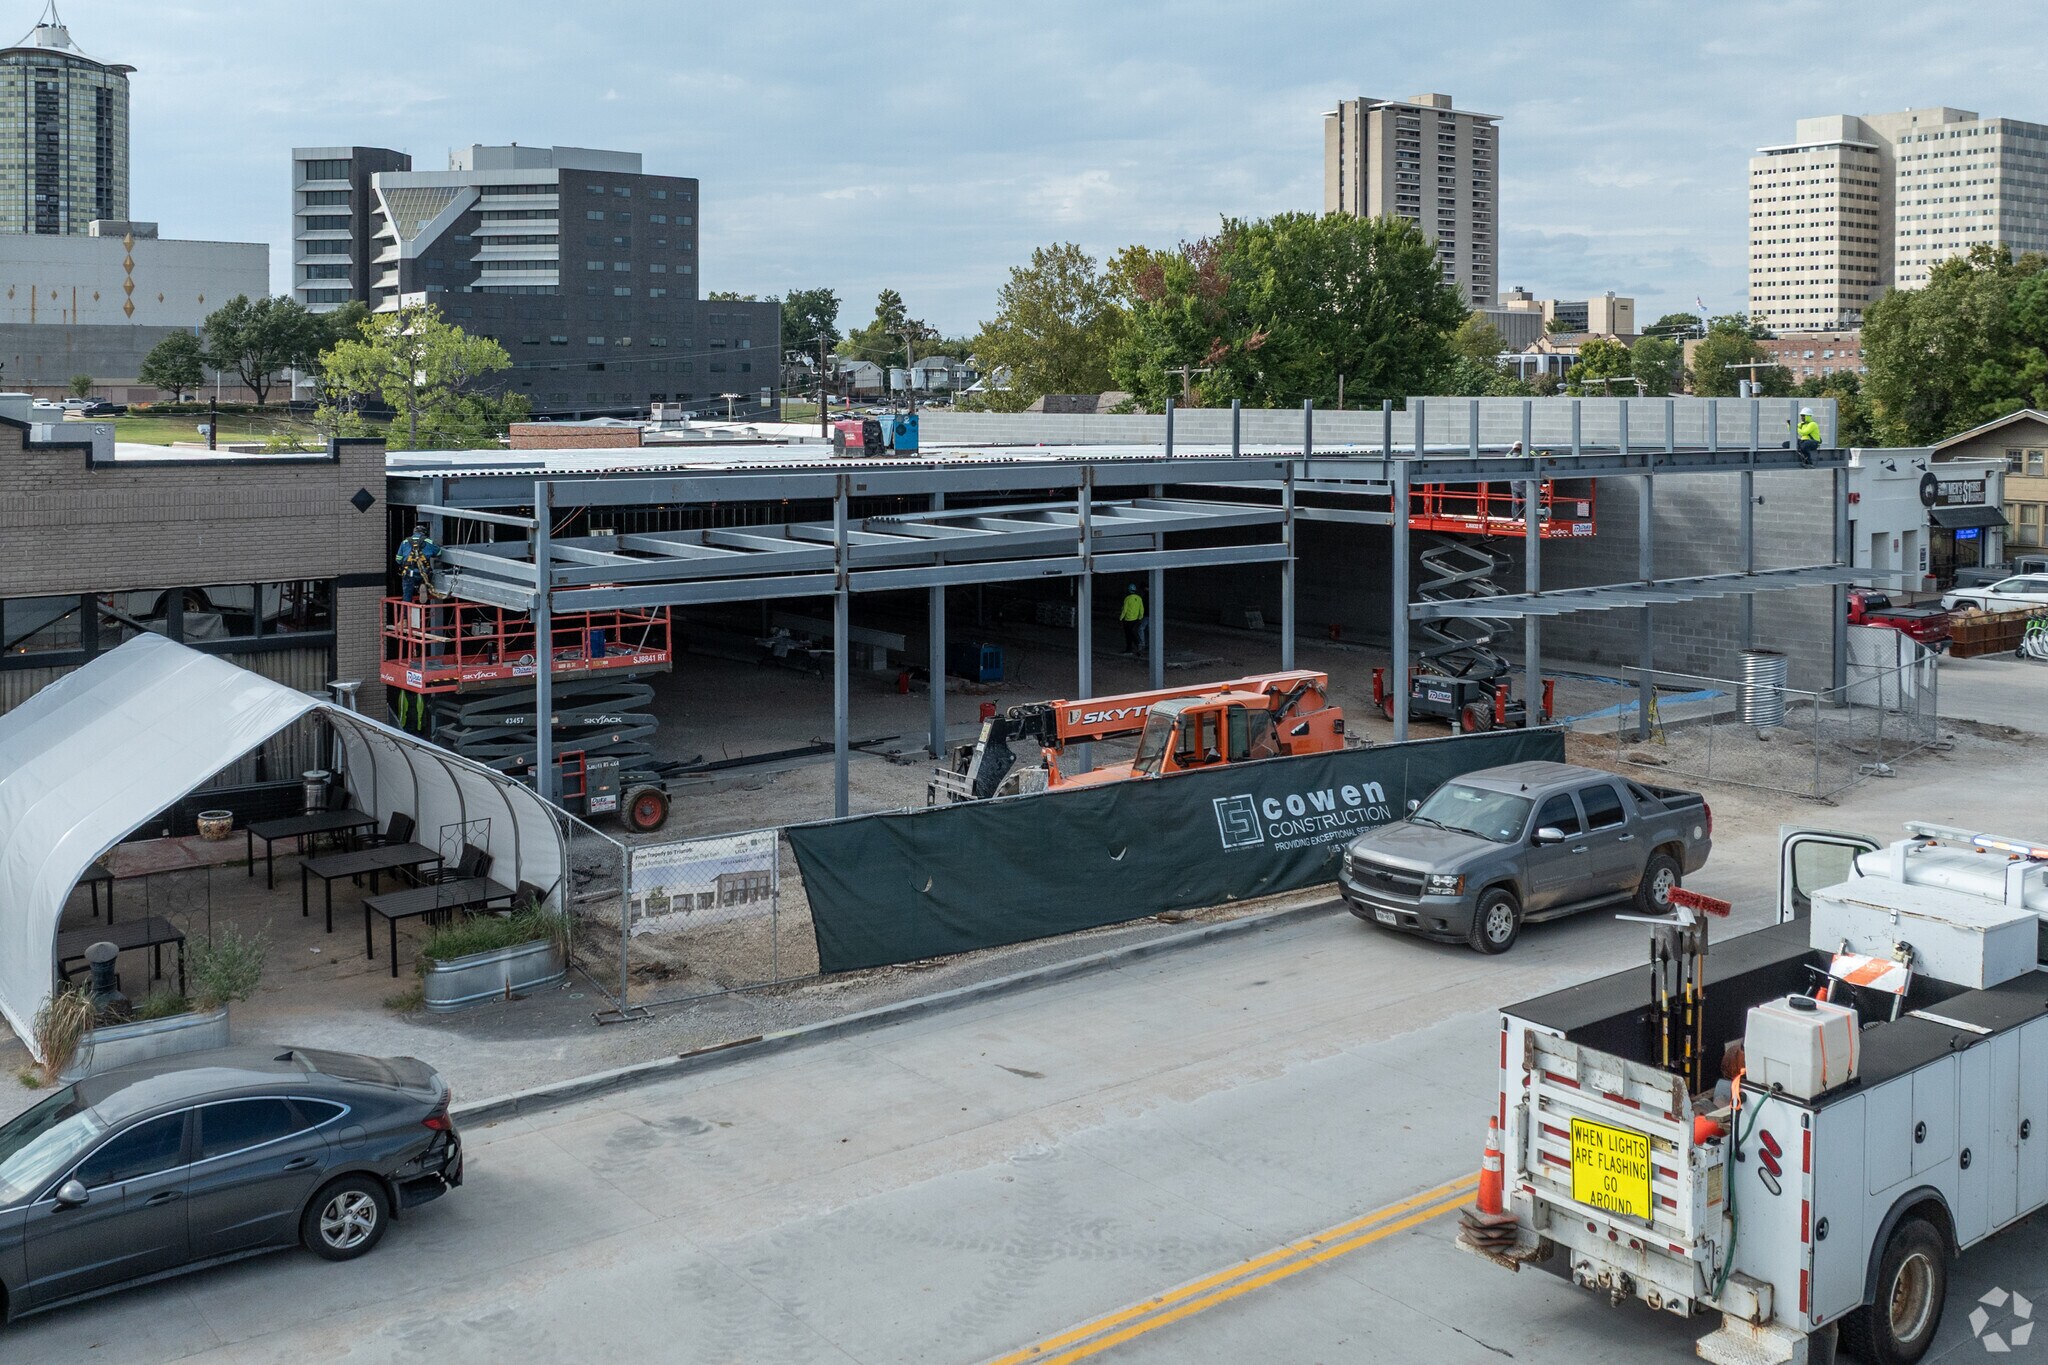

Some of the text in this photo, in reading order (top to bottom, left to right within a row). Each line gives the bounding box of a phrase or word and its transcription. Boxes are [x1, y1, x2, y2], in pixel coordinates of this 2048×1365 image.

[633, 653, 666, 664] SJ8841 RT
[463, 671, 498, 680] SKYJACK
[584, 715, 622, 725] SKYJACK
[1268, 805, 1392, 839] CONSTRUCTION
[1274, 837, 1311, 852] PROVIDING
[1311, 829, 1357, 845] EXCEPTIONAL
[1574, 1125, 1646, 1159] WHEN LIGHTS
[1575, 1147, 1646, 1181] ARE FLASHING
[1604, 1175, 1618, 1193] GO
[1589, 1190, 1632, 1216] AROUND
